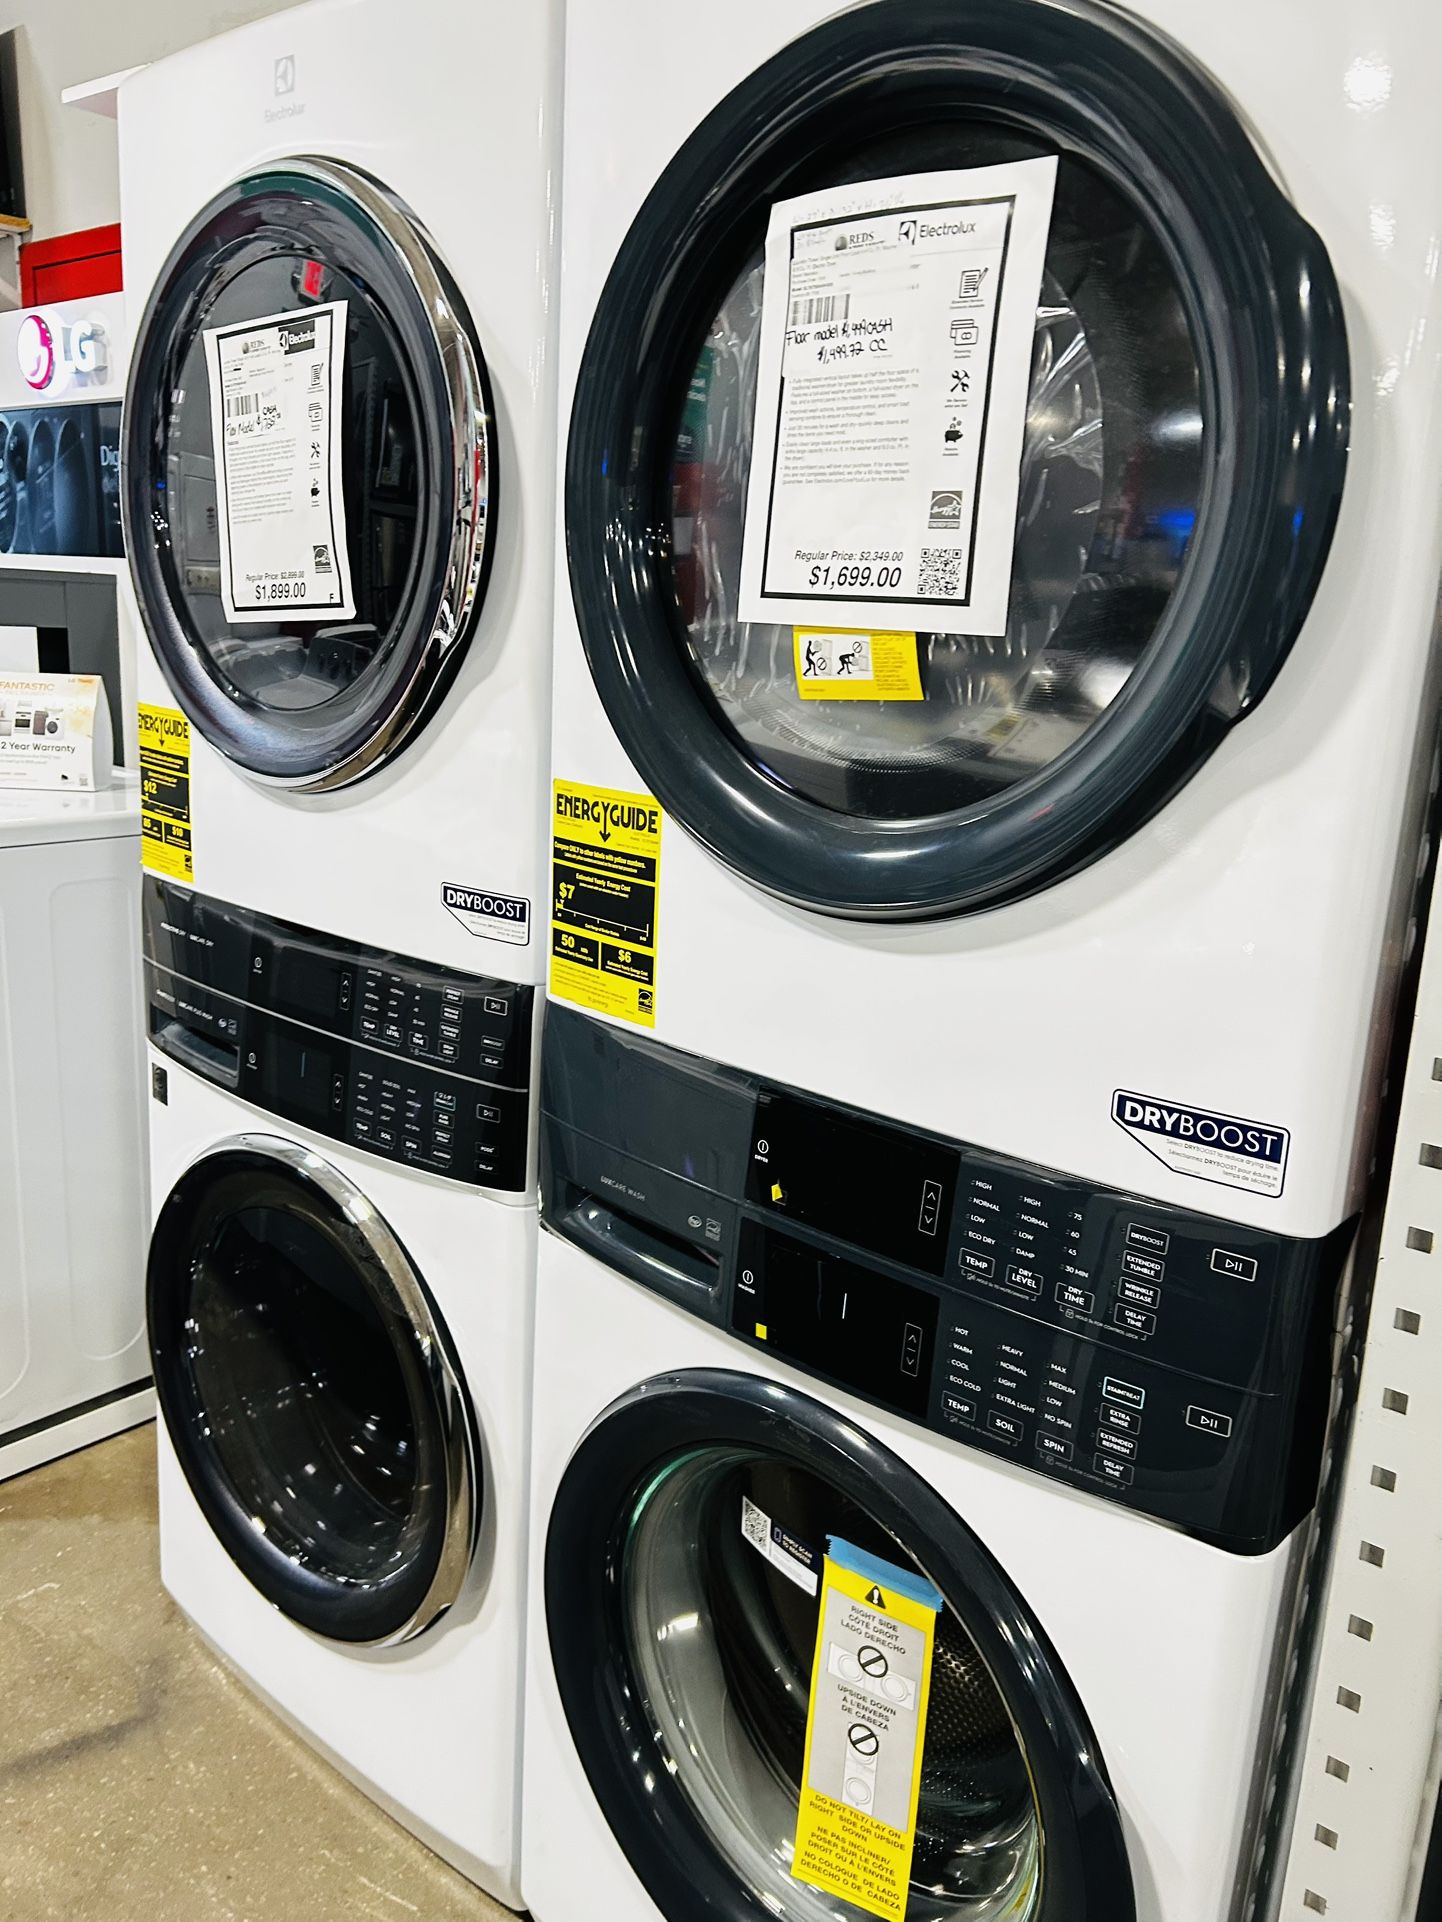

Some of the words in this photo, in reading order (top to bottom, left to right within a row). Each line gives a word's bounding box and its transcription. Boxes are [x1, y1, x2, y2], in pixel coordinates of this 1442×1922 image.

[920, 221, 976, 238] Electrolux
[850, 231, 875, 243] REDS
[814, 325, 838, 340] model
[60, 319, 106, 377] LG
[795, 550, 829, 562] Regular
[831, 550, 857, 561] Price:
[859, 551, 903, 562] $2,349.00
[246, 572, 263, 583] Regular
[809, 566, 901, 589] $1,699.00
[256, 582, 306, 602] $1,899.00
[0, 681, 55, 691] FANTASTIC
[9, 742, 30, 750] Year
[33, 742, 75, 753] Warranty
[557, 793, 658, 834] ENERGYGUIDE
[559, 882, 575, 899] $7
[607, 881, 621, 890] Energy
[621, 884, 631, 892] Cost
[447, 889, 523, 918] DRYBOOST
[561, 934, 575, 948] 50
[618, 950, 631, 963] $6
[1124, 1101, 1278, 1155] DRYBOOST
[1184, 1144, 1216, 1156] DRYBOOST
[1204, 1158, 1237, 1171] DRYBOOST
[975, 1180, 992, 1190] HIGH
[973, 1197, 1000, 1212] NORMAL
[1024, 1196, 1041, 1207] HIGH
[970, 1214, 986, 1224] LOW
[1021, 1214, 1049, 1229] NORMAL
[1073, 1212, 1082, 1221] 75
[968, 1231, 982, 1241] ECO
[982, 1235, 996, 1245] DRY
[1018, 1231, 1034, 1241] LOW
[1070, 1231, 1080, 1239] 60
[1130, 1232, 1164, 1247] DRYBOOST
[1016, 1248, 1036, 1259] DAMP
[1068, 1248, 1076, 1256] 45
[965, 1256, 988, 1269] TEMP
[1127, 1255, 1161, 1270] EXTENDED
[1019, 1268, 1033, 1278] DRY
[1065, 1265, 1074, 1274] 30
[1075, 1268, 1089, 1278] MIN
[1130, 1264, 1155, 1277] TUMBLE
[1012, 1273, 1037, 1289] LEVEL
[1068, 1286, 1082, 1295] DRY
[1125, 1282, 1154, 1297] WRINKLE
[1064, 1292, 1085, 1306] TIME
[1124, 1290, 1152, 1304] RELEASE
[1125, 1310, 1146, 1322] DELAY
[955, 1327, 968, 1336] HOT
[953, 1343, 973, 1355] WARM
[1002, 1344, 1024, 1356] HEAVY
[951, 1360, 969, 1371] COOL
[1000, 1361, 1028, 1376] NORMAL
[1051, 1363, 1066, 1374] MAX
[950, 1375, 963, 1385] ECO
[963, 1380, 981, 1392] COLD
[998, 1377, 1016, 1389] LIGHT
[1049, 1380, 1076, 1395] MEDIUM
[948, 1399, 970, 1412] TEMP
[996, 1394, 1016, 1406] EXTRA
[1017, 1401, 1036, 1414] LIGHT
[1046, 1397, 1062, 1406] LOW
[1044, 1413, 1056, 1422] NO
[1056, 1418, 1072, 1429] SPIN
[1109, 1409, 1131, 1421] EXTRA
[995, 1419, 1015, 1433] SOIL
[1044, 1439, 1065, 1453] SPIN
[1100, 1432, 1134, 1448] EXTENDED
[1103, 1460, 1125, 1471] DELAY
[851, 1605, 876, 1622] RIGHT
[879, 1619, 898, 1632] SIDE
[849, 1613, 871, 1630] CÔTÉ
[873, 1626, 900, 1642] DROIT
[841, 1619, 862, 1635] LADO
[864, 1632, 906, 1655] DERECHO
[838, 1684, 868, 1703] UPSIDE
[870, 1699, 896, 1716] DOWN
[842, 1705, 853, 1715] DE
[855, 1711, 889, 1731] CABEZA
[850, 1700, 890, 1722] L'ENVERS
[816, 1795, 827, 1804] DO
[830, 1801, 847, 1813] NOT
[850, 1810, 868, 1824] TILT/
[871, 1821, 886, 1833] LAY
[888, 1830, 901, 1839] ON
[810, 1801, 834, 1817] RIGHT
[839, 1814, 857, 1828] SIDE
[860, 1825, 872, 1835] OR
[875, 1832, 905, 1851] UPSIDE
[842, 1826, 867, 1842] DOWN
[811, 1833, 838, 1850] POSER
[841, 1845, 857, 1858] SUR
[860, 1854, 869, 1864] LE
[817, 1826, 828, 1836] NE
[831, 1832, 846, 1844] PAS
[849, 1840, 891, 1865] INCLINER/
[808, 1840, 833, 1855] DROIT
[835, 1852, 847, 1862] OU
[857, 1864, 896, 1886] L'ENVERS
[805, 1851, 816, 1860] NO
[819, 1857, 858, 1880] COLOQUE
[863, 1879, 874, 1888] DE
[877, 1886, 899, 1900] LADO
[801, 1859, 841, 1882] DERECHO
[843, 1878, 849, 1886] O
[851, 1883, 862, 1893] DE
[867, 1891, 900, 1910] CABEZA
